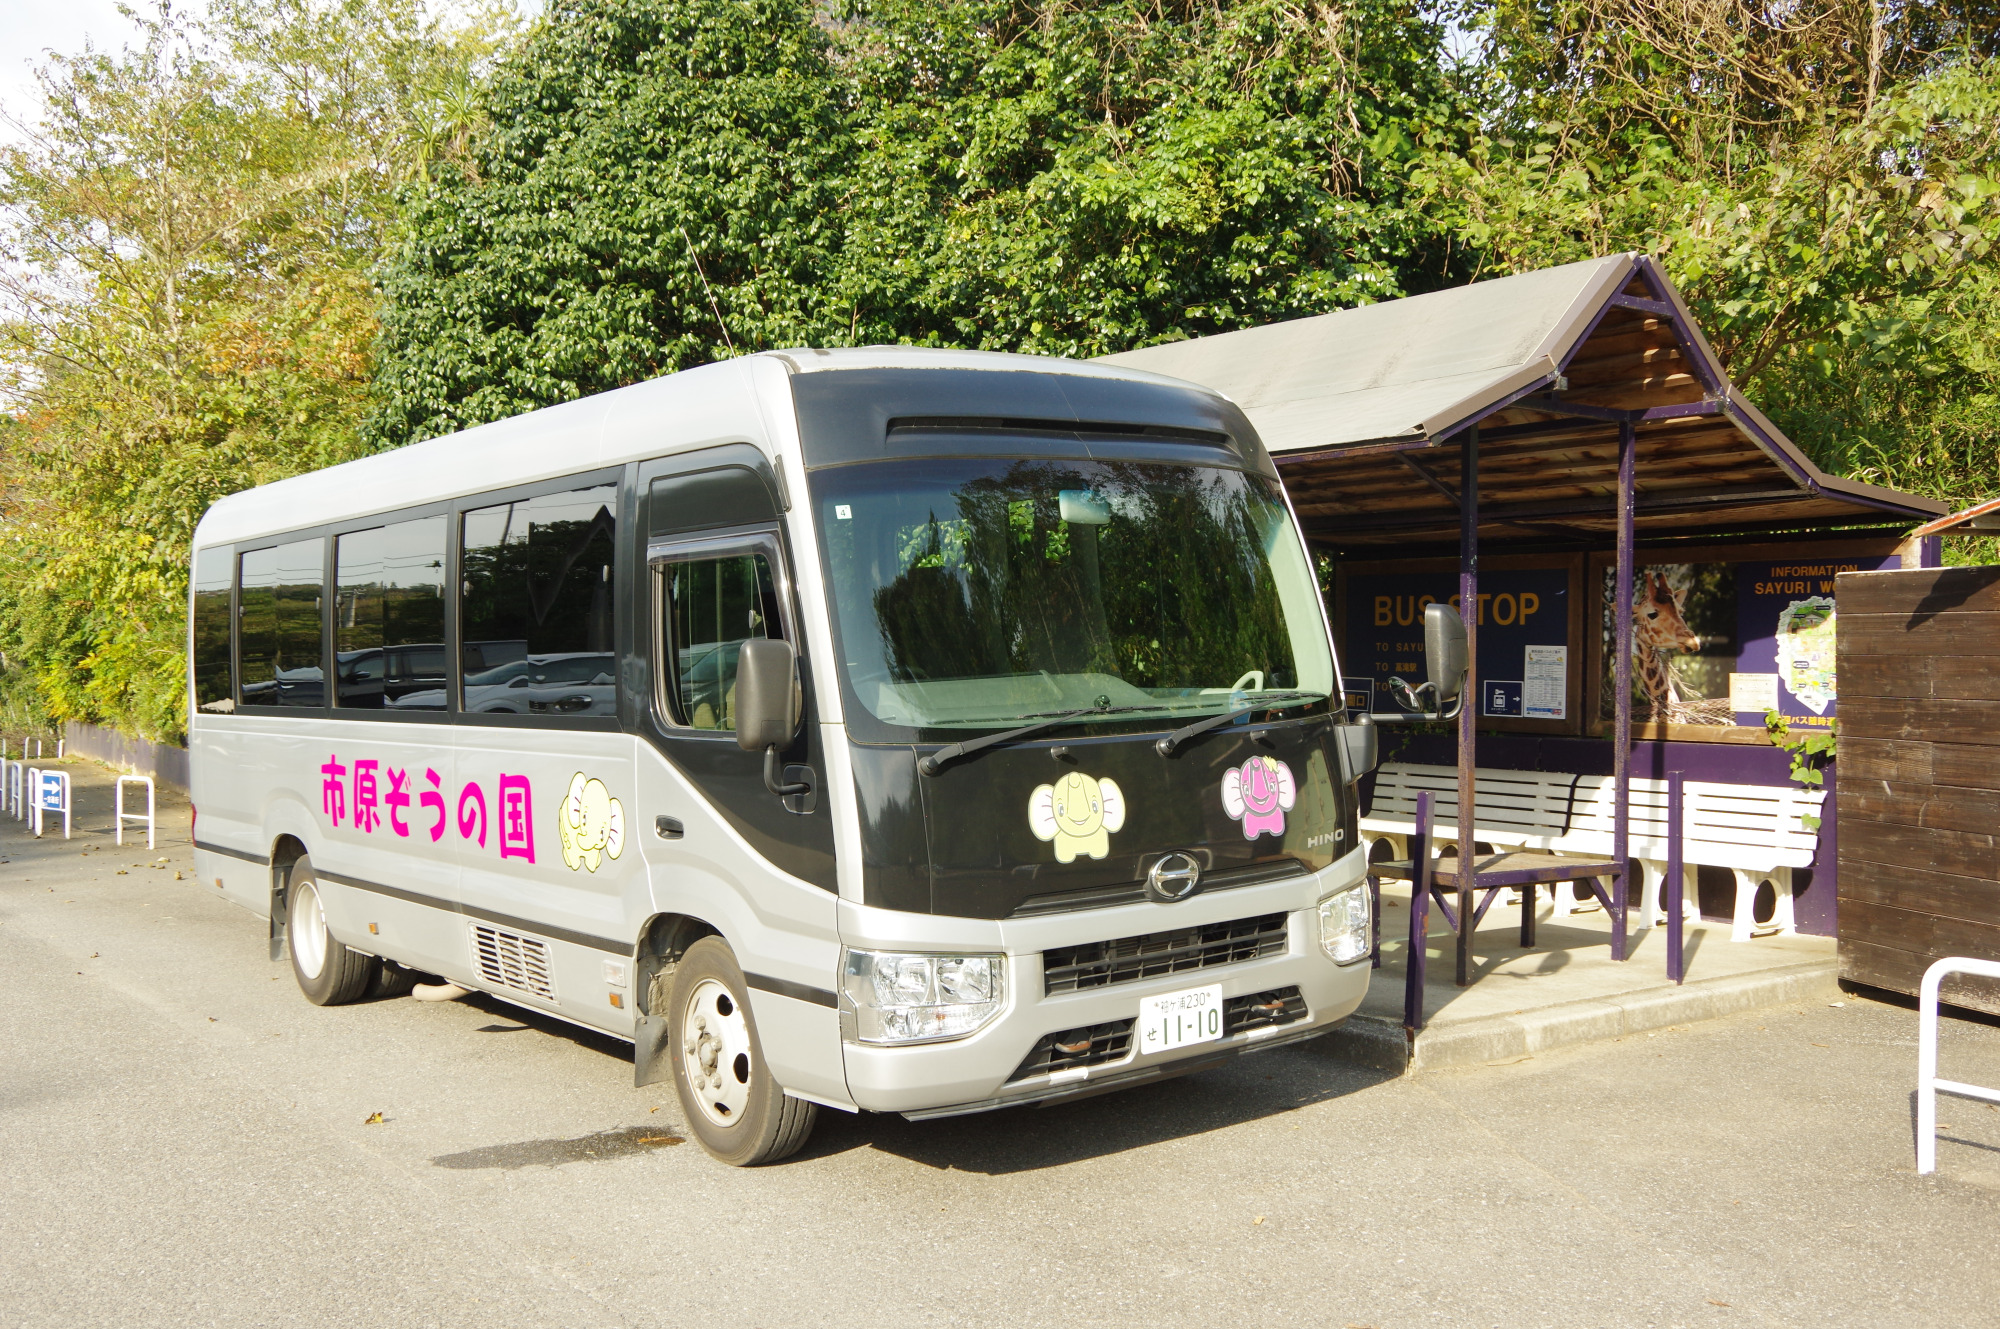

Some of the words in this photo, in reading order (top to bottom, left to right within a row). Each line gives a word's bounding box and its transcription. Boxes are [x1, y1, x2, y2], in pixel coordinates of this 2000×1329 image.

[1771, 564, 1858, 577] INFORMATION
[1754, 581, 1811, 594] SAYURI
[1375, 642, 1389, 652] TO
[1375, 662, 1389, 672] TO
[1375, 682, 1389, 692] TO
[321, 754, 536, 864] 市原ぞうの国
[1307, 828, 1344, 849] HINO
[1147, 1027, 1157, 1041] せ
[1164, 1008, 1218, 1045] 11-10
